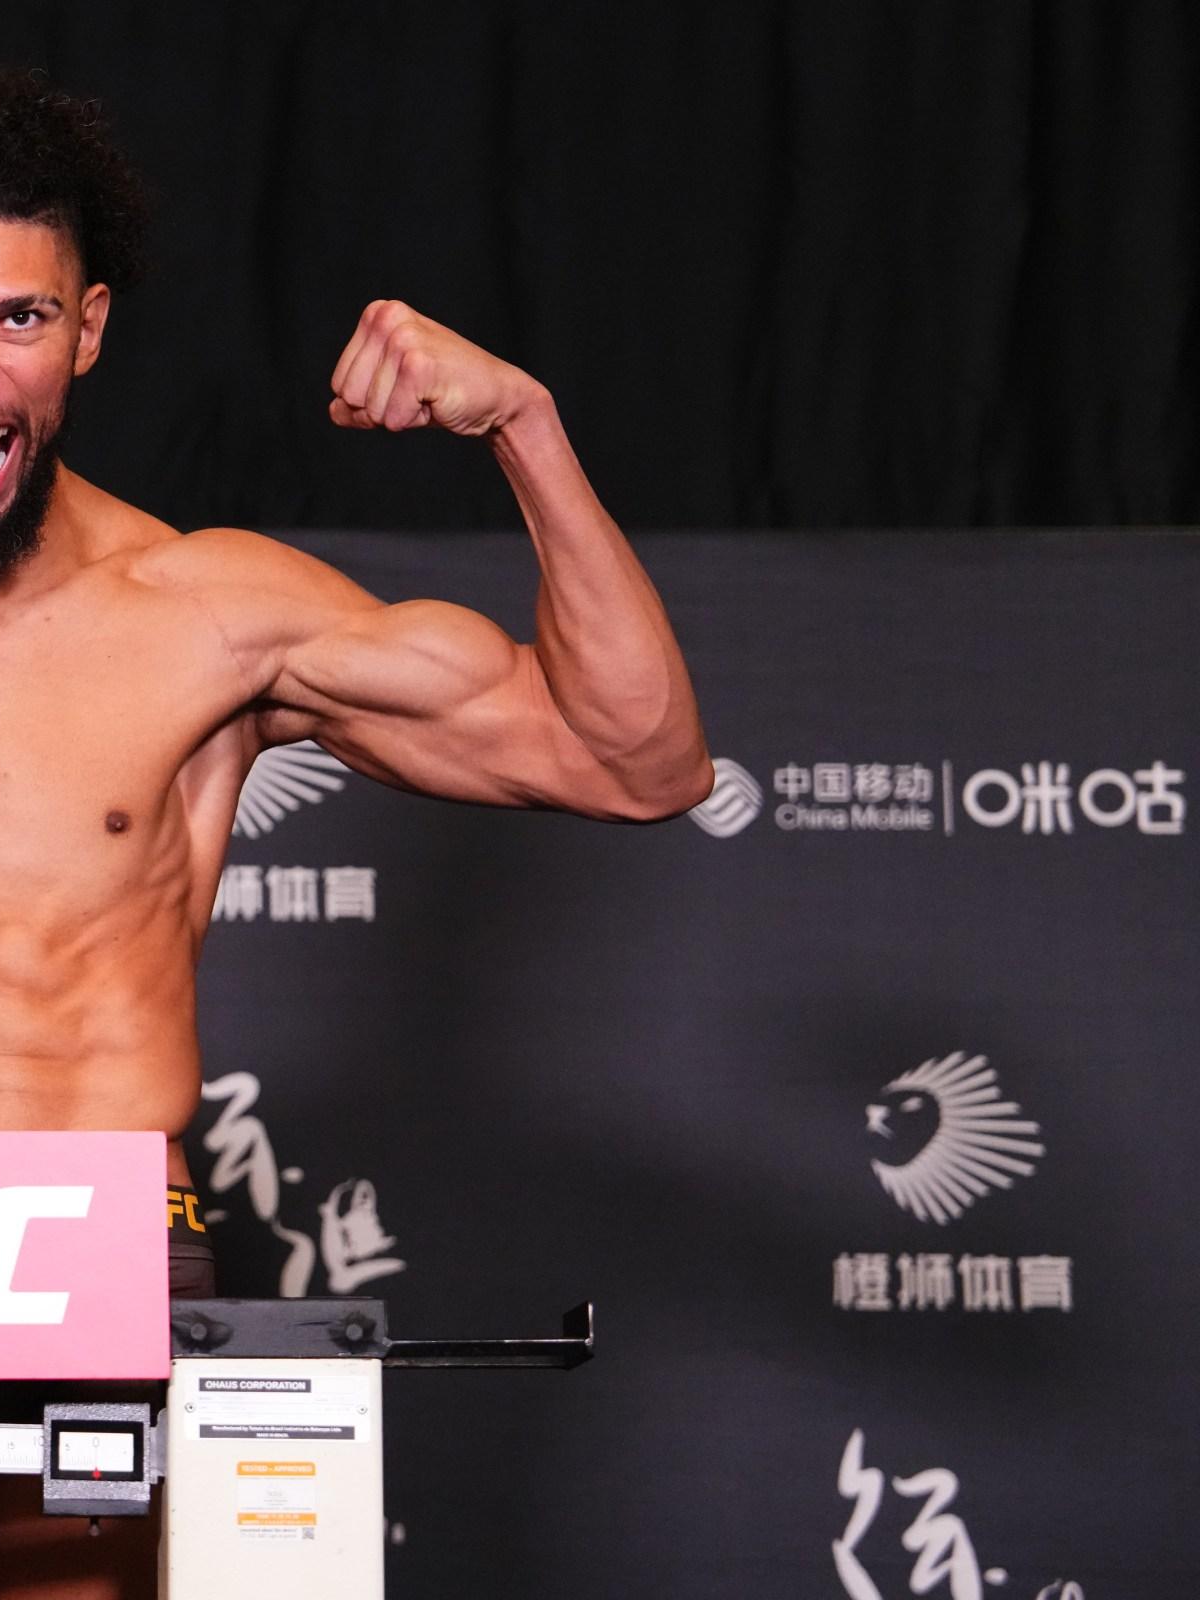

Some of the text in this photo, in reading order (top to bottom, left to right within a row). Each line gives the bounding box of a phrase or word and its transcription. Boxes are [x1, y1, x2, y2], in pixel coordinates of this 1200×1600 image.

[774, 803, 934, 831] China Mobile
[205, 1380, 306, 1391] OHAUS CORPORATION
